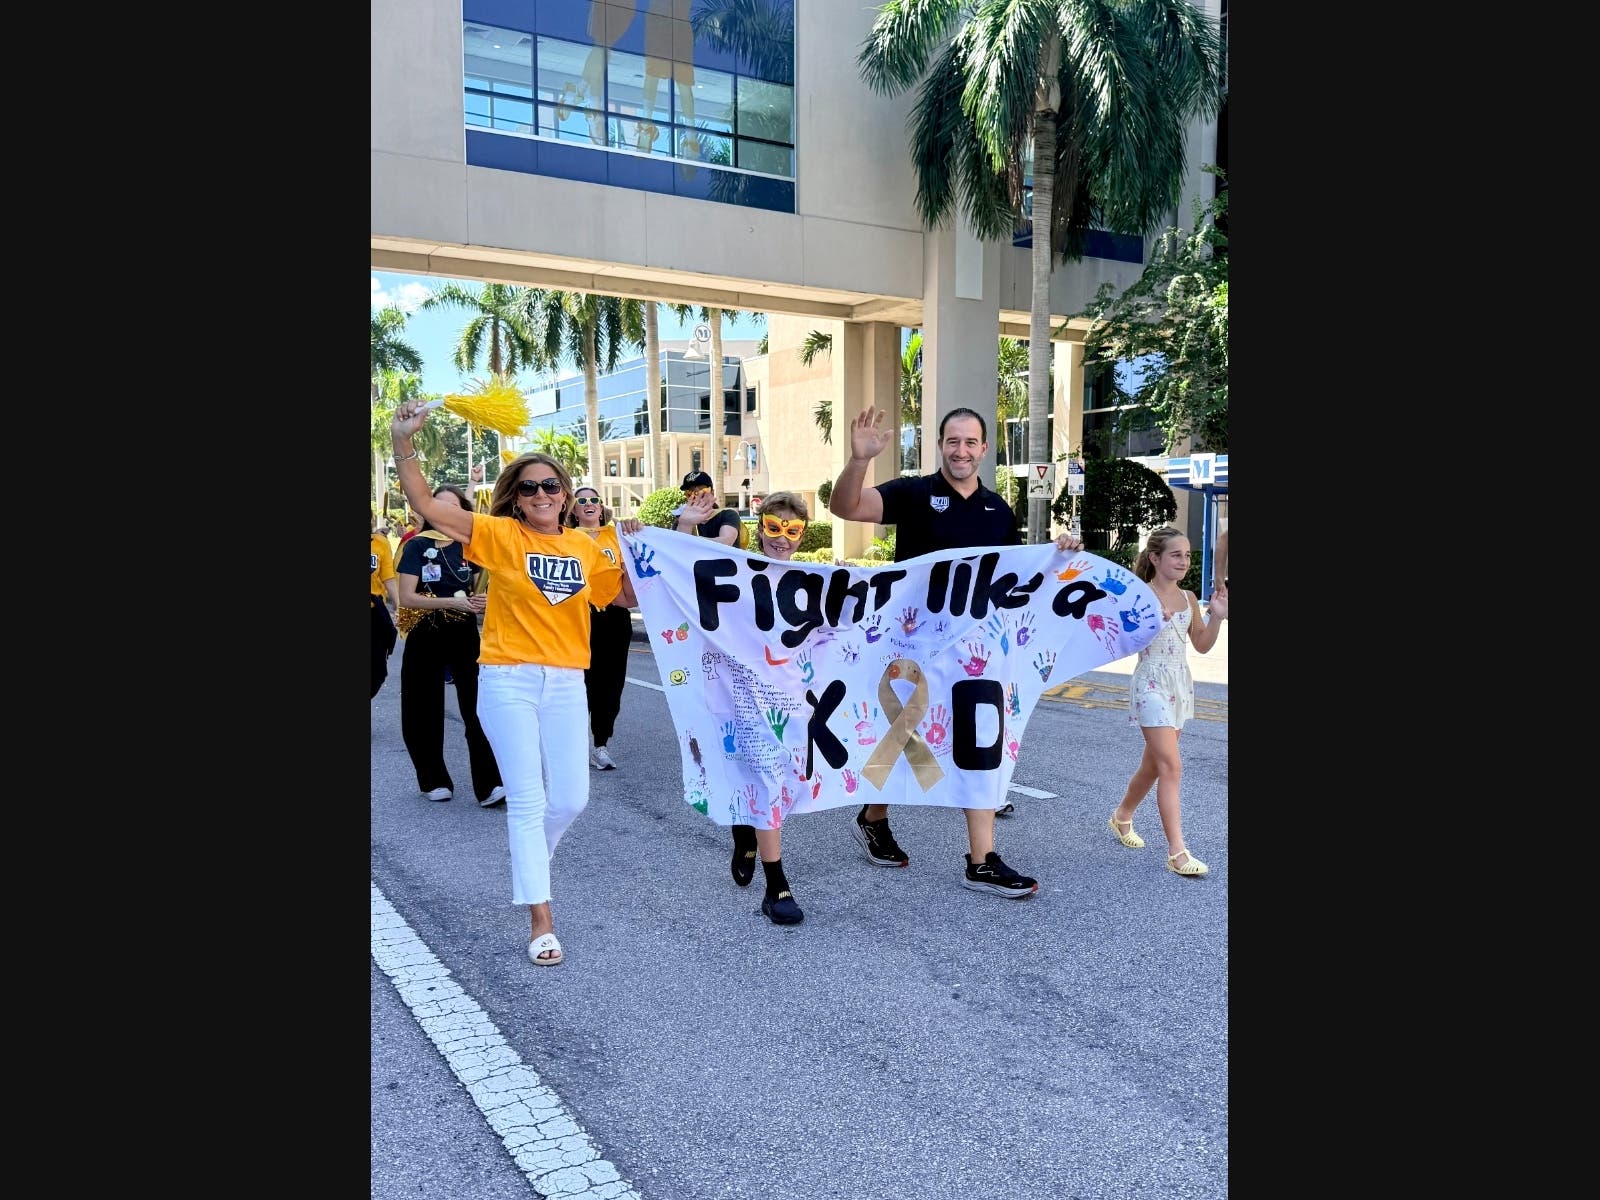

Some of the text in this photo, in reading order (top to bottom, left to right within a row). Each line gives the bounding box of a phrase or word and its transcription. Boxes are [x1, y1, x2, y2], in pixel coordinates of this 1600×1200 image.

[1193, 459, 1211, 479] M
[529, 556, 583, 581] RIZZO
[693, 552, 1108, 649] Fight like a
